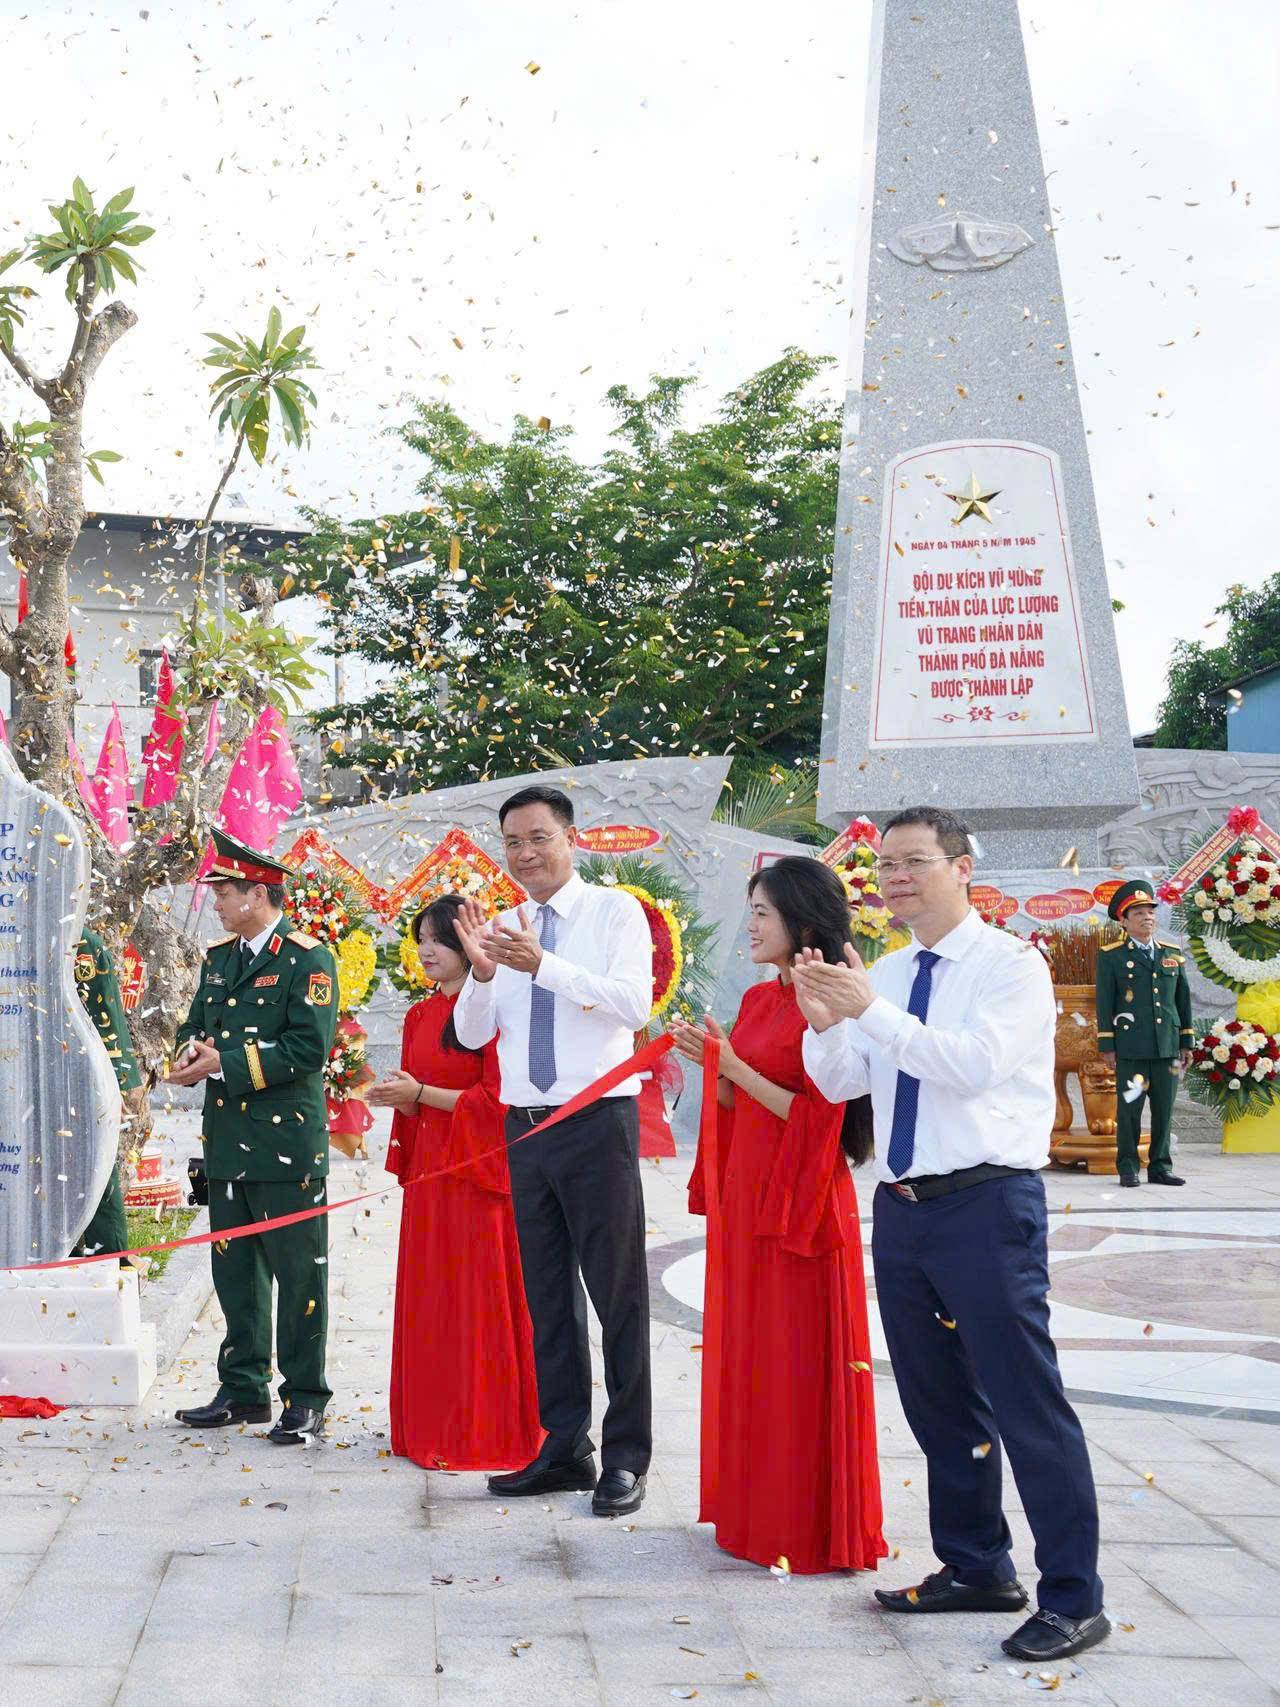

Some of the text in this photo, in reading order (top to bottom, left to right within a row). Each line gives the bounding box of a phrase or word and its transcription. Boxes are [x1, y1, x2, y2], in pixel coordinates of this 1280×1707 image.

[937, 541, 948, 550] 04
[982, 538, 988, 548] 5
[1015, 536, 1036, 546] 1945
[913, 569, 933, 596] ĐỘI
[937, 571, 953, 591] DU
[956, 568, 985, 590] KÍCH
[988, 566, 1005, 589] VŨ
[928, 596, 960, 618] THÂN
[964, 592, 988, 617] CỦA
[992, 594, 1015, 619] LỰC
[1019, 594, 1059, 617] LƯỢNG
[917, 618, 1043, 645] VŨ TRANG NHÂN DÂN
[918, 643, 1045, 673] THÀNH PHỐ ĐÀ NẴNG
[931, 674, 1034, 702] ĐƯỢC THÀNH LẬP
[0, 965, 38, 979] thành
[0, 1142, 22, 1157] huy
